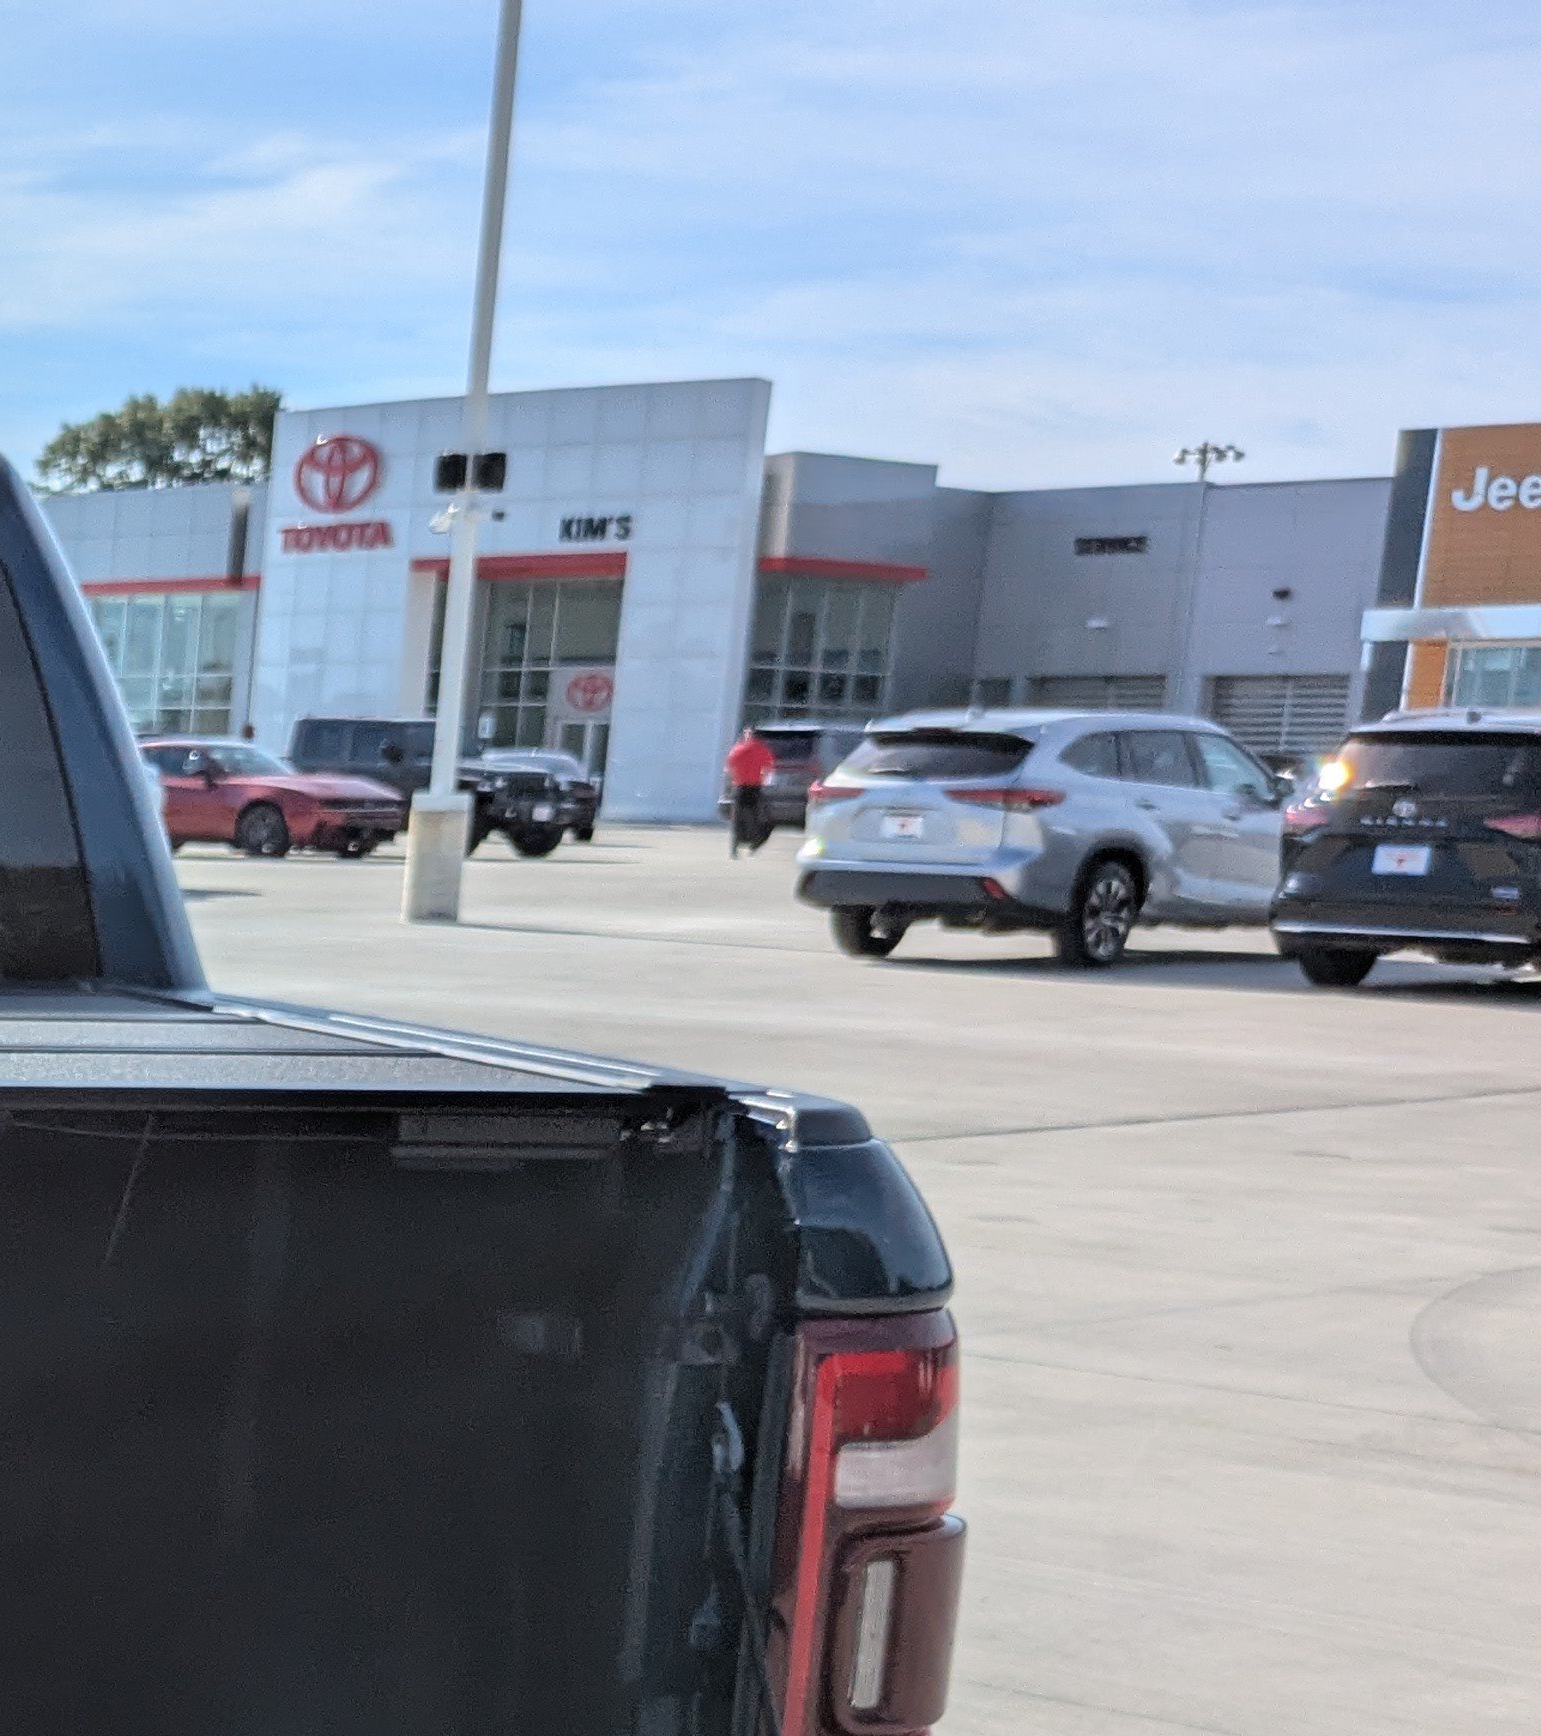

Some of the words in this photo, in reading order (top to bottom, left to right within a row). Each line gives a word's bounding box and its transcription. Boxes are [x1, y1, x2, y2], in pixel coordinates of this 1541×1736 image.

[1451, 465, 1541, 512] Jee
[280, 521, 394, 554] TOYOTA
[558, 514, 632, 542] KIM'S
